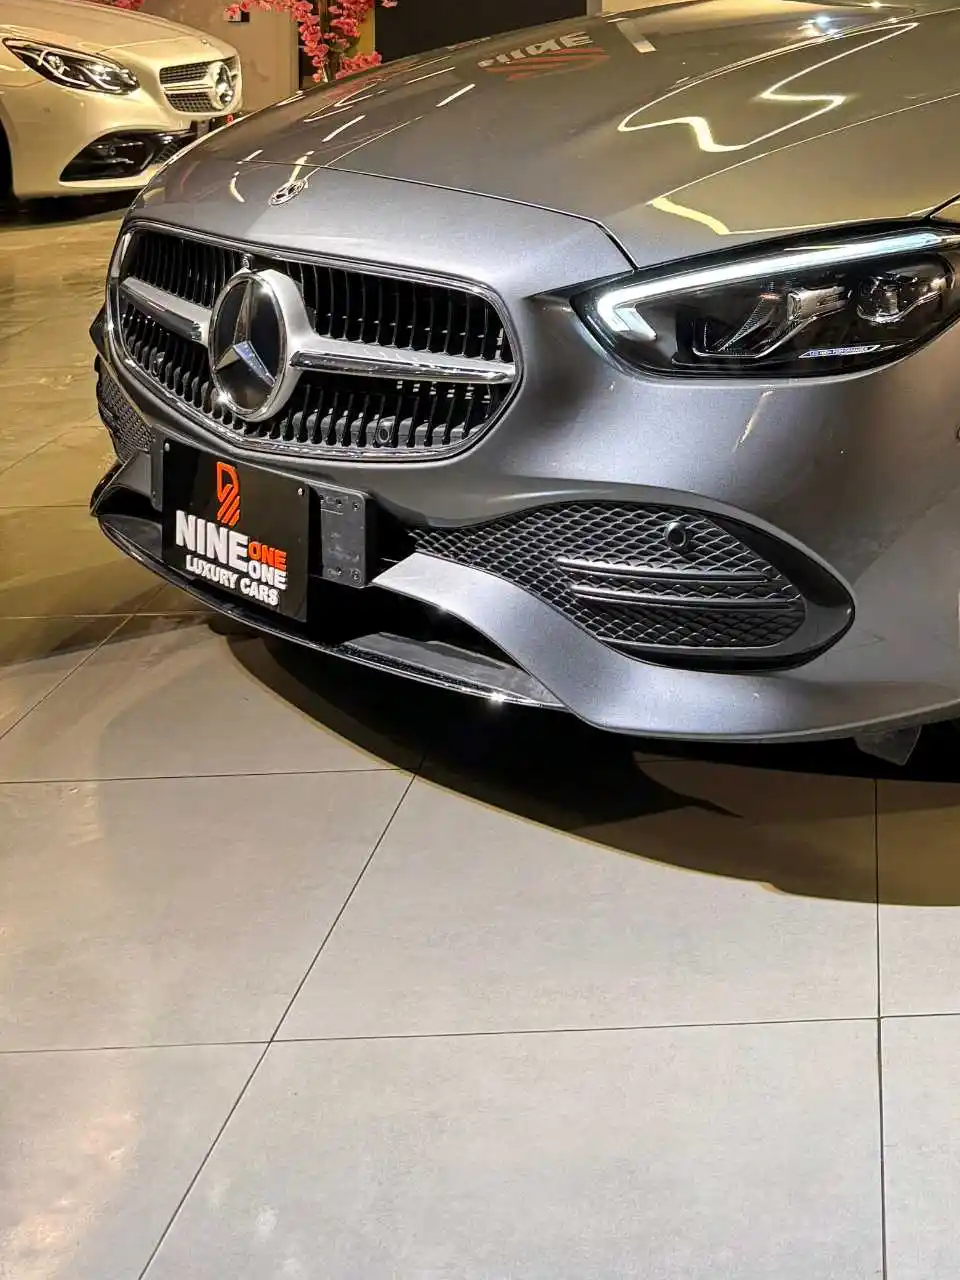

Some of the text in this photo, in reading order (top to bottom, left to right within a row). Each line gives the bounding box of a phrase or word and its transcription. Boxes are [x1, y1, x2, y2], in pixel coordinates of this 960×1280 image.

[175, 509, 287, 573] NINE ONE
[185, 553, 280, 606] LUXURY CARS
[248, 559, 288, 590] ONE
